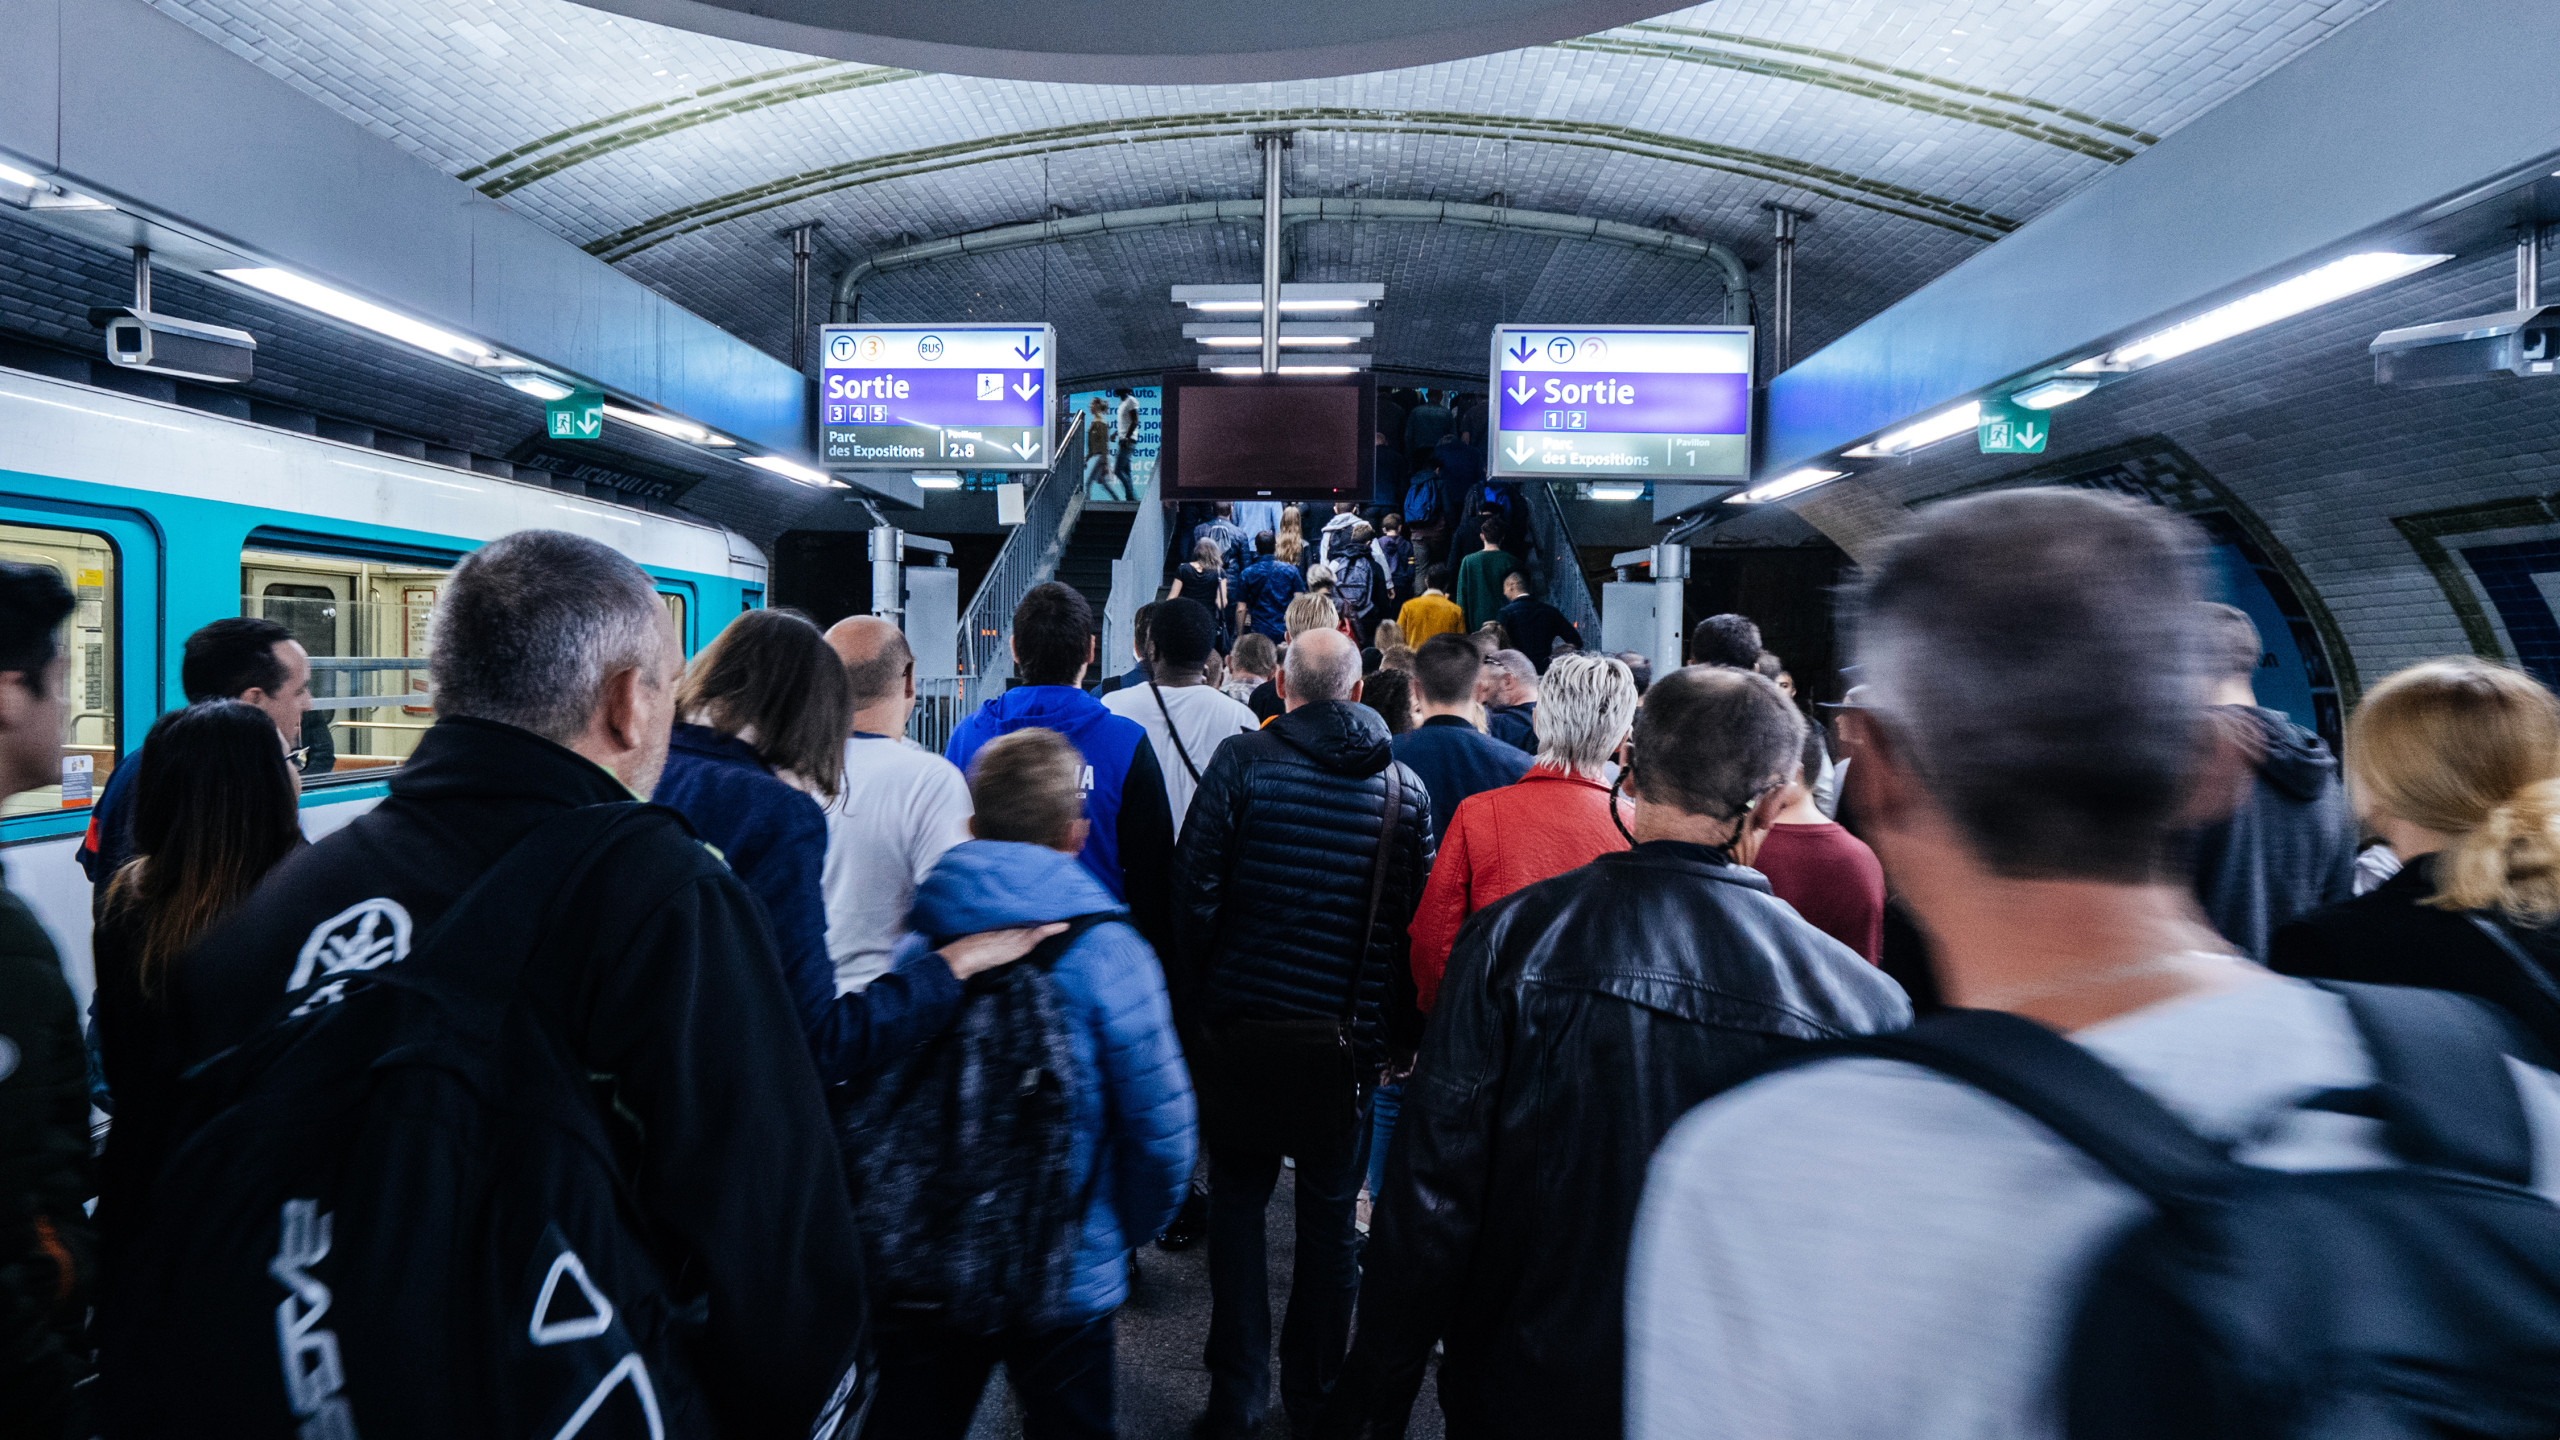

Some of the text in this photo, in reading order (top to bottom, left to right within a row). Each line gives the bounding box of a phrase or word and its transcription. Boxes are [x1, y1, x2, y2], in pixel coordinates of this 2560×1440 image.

[838, 341, 941, 356] T 3 BUS
[1554, 343, 1569, 358] T
[828, 374, 910, 400] Sortie
[1544, 378, 1635, 404] Sortie
[1571, 413, 1582, 427] 2
[829, 431, 856, 442] Parc
[1542, 437, 1573, 450] Parc
[1676, 438, 1710, 447] Pavillon
[828, 445, 925, 459] des Expositions
[1542, 452, 1649, 467] des Expositions
[1686, 450, 1695, 467] 1
